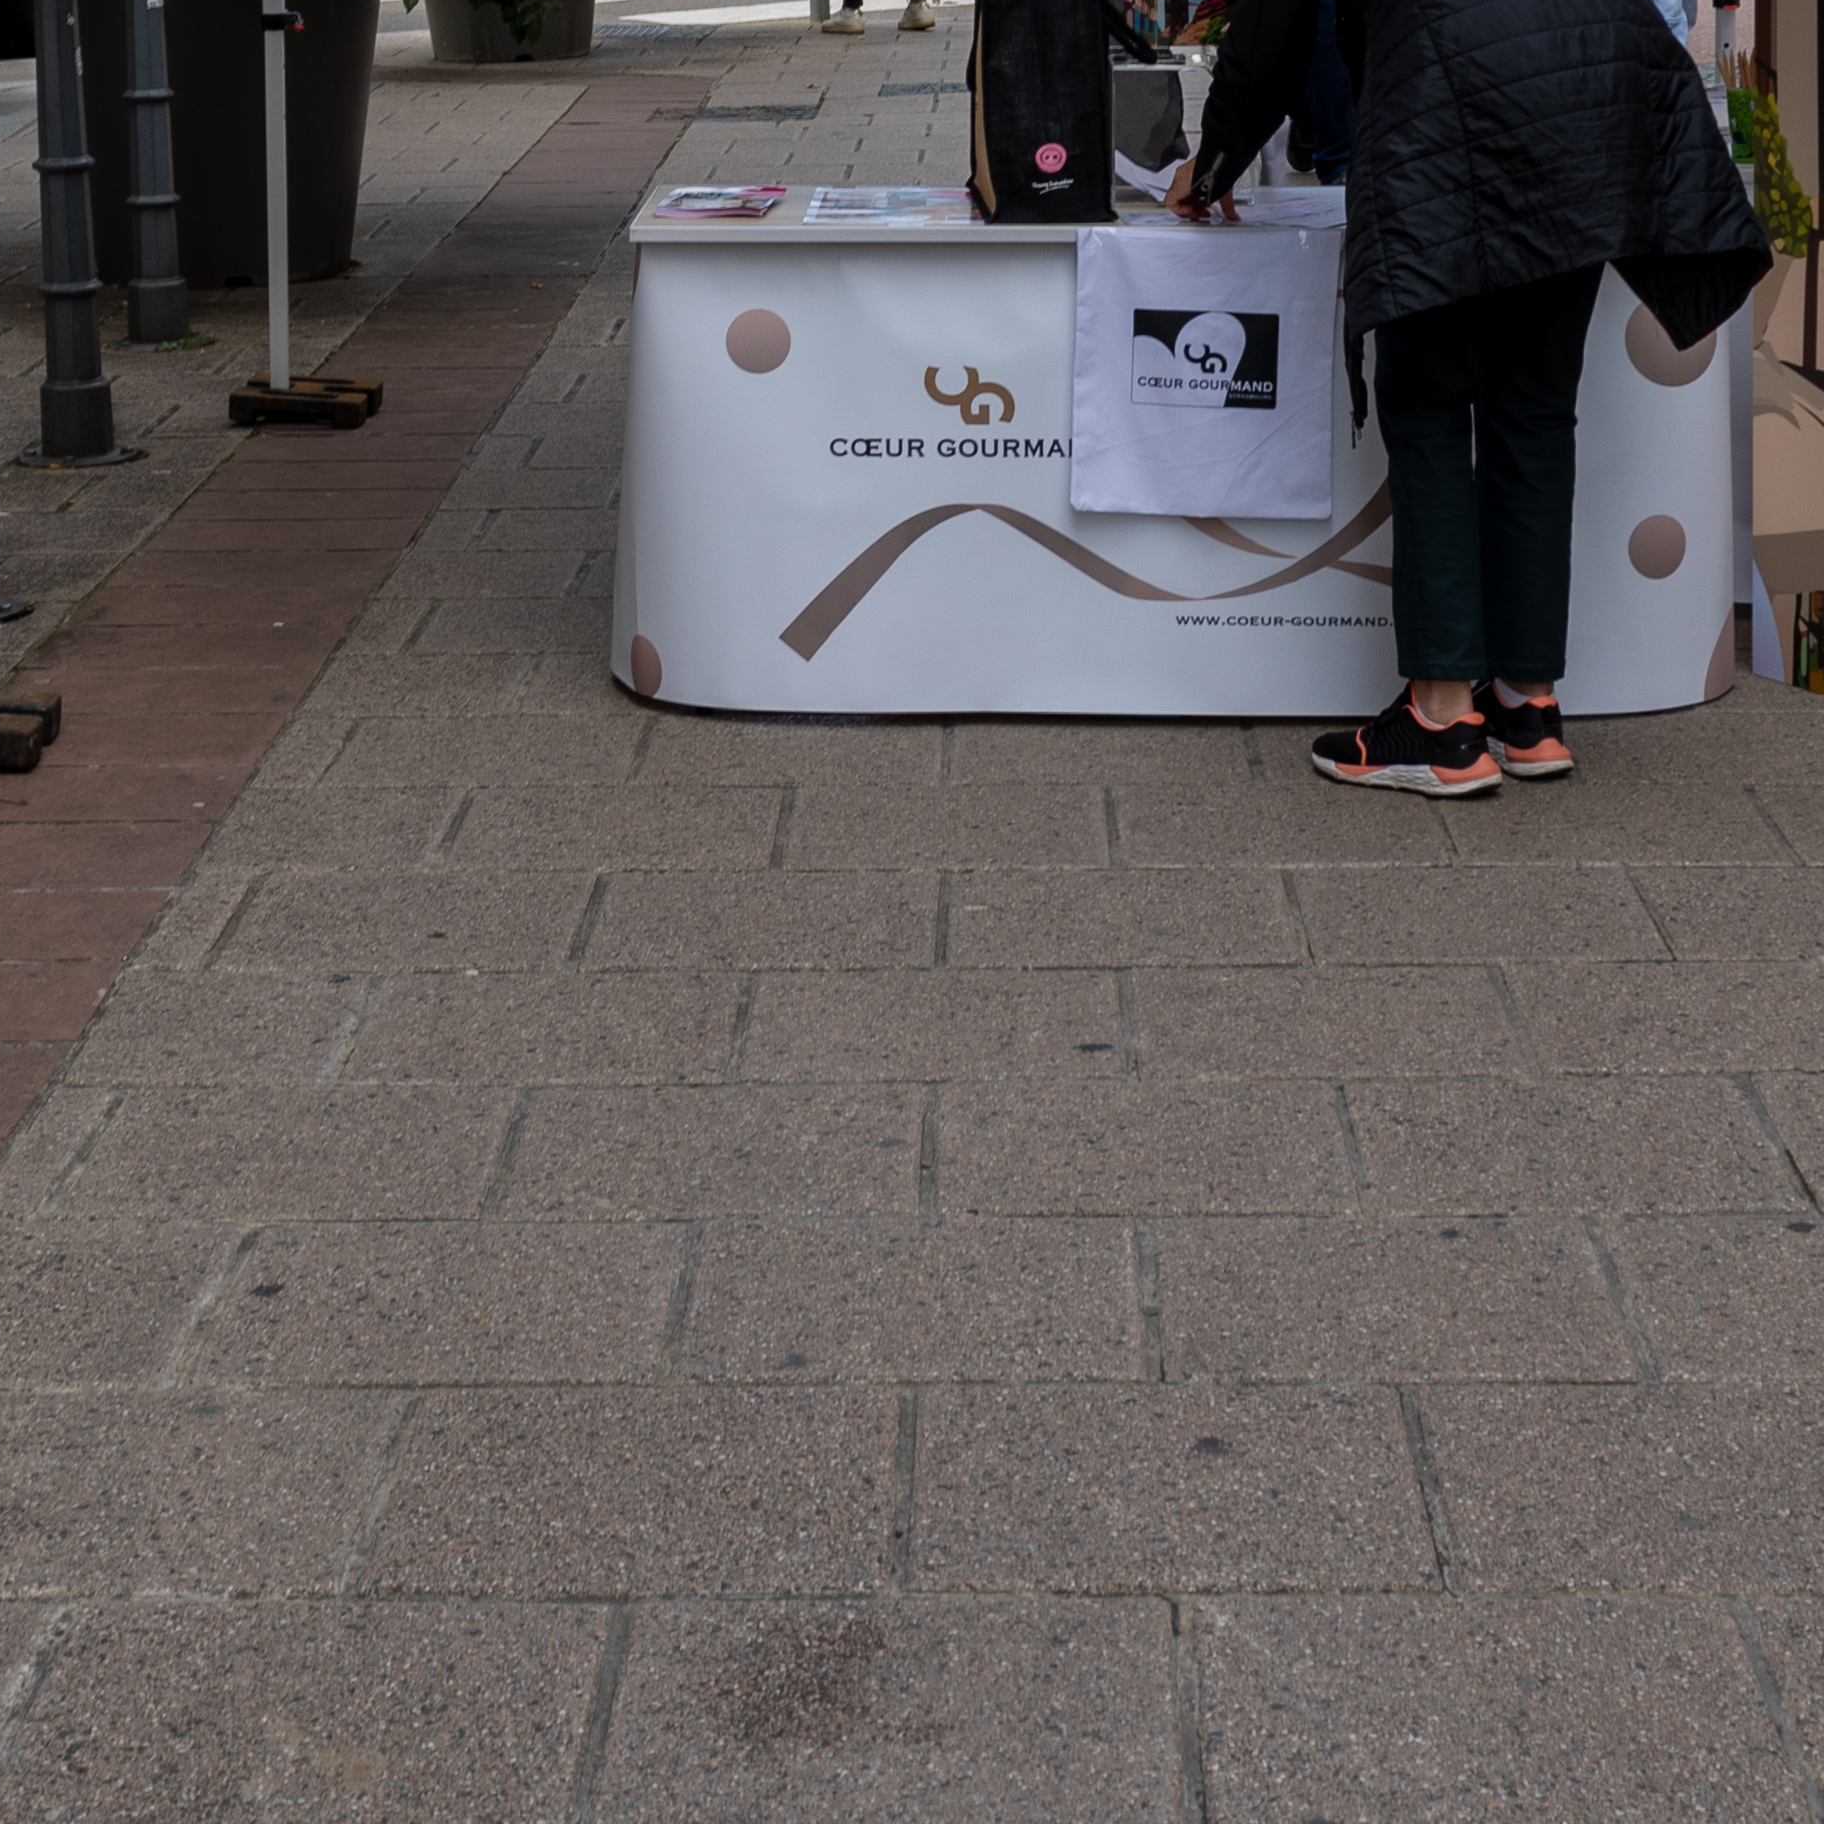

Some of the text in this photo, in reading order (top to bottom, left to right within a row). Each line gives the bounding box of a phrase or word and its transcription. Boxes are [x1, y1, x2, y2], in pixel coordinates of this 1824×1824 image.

[1188, 378, 1274, 393] GOURMAND
[829, 437, 1073, 458] CŒUR GOURMA
